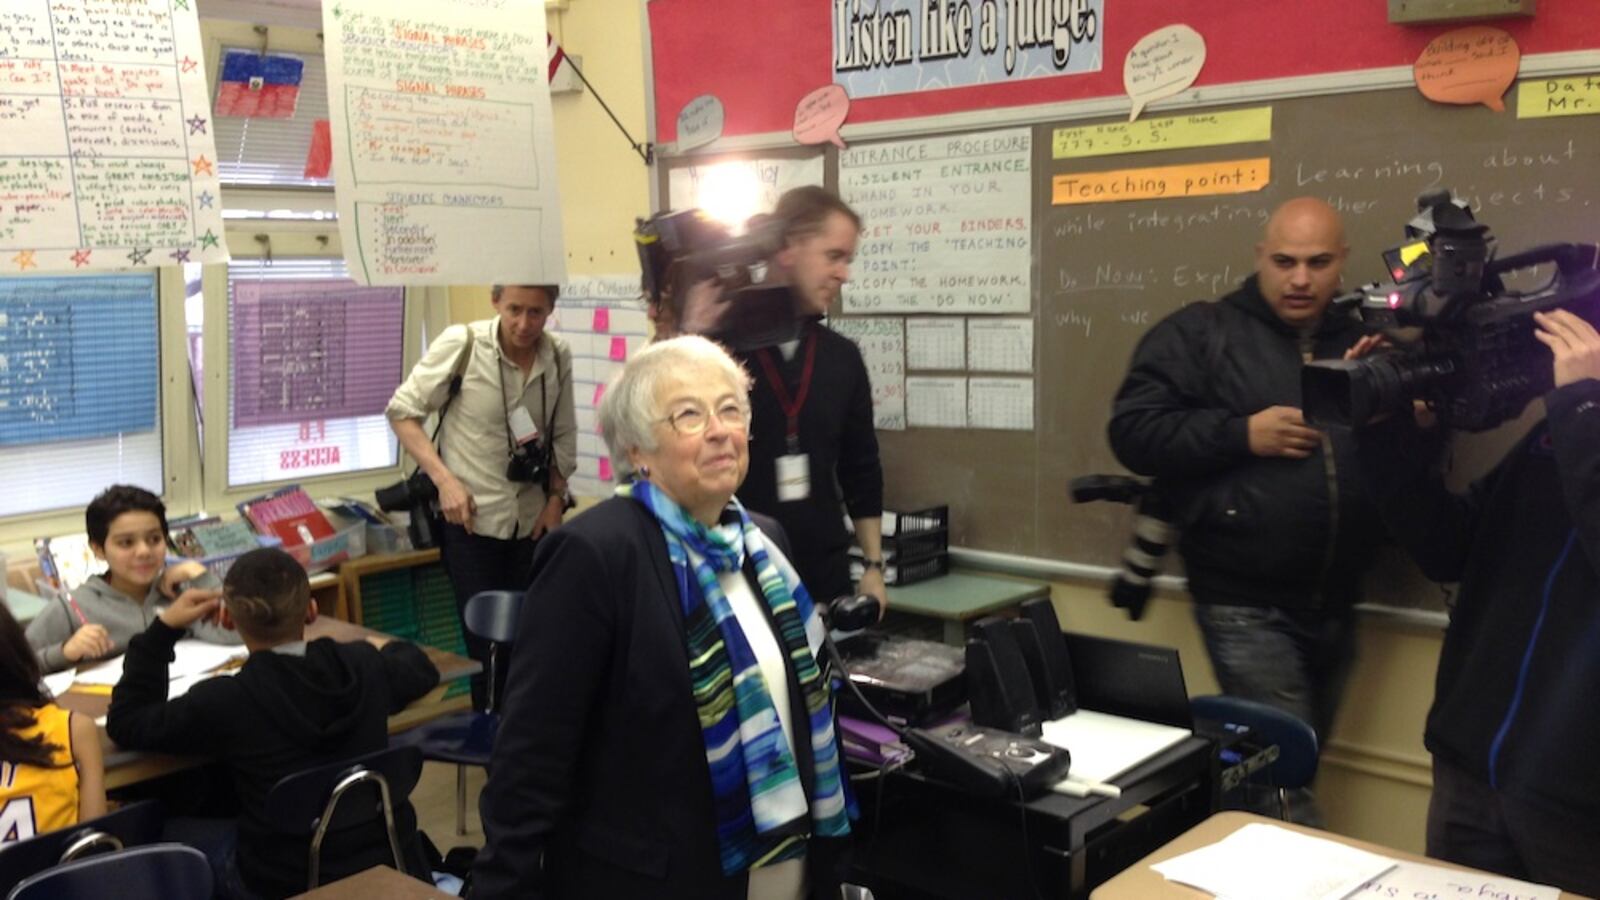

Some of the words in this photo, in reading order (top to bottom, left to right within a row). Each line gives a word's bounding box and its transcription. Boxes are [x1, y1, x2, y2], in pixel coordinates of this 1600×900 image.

[68, 15, 81, 24] As
[395, 26, 439, 43] SIGNAL
[443, 34, 487, 50] PHRASES
[836, 0, 913, 73] Listen
[919, 0, 972, 62] like
[980, 0, 998, 54] a
[1004, 0, 1096, 76] judge.
[395, 79, 439, 93] SIGNAL
[444, 85, 487, 98] PHRASES
[1547, 97, 1592, 113] Mr.
[1188, 115, 1218, 125] Name
[840, 143, 928, 167] ENTRANCE
[946, 135, 1031, 156] PROCEDURE
[940, 158, 1030, 179] ENTRANCE.
[1296, 160, 1443, 187] Learning
[1483, 139, 1576, 169] about
[911, 186, 932, 197] IN
[949, 180, 1002, 196] YOUR
[1059, 178, 1167, 199] Teaching
[1185, 168, 1257, 195] point:
[1053, 213, 1106, 237] while
[1127, 205, 1270, 233] integrating
[1326, 196, 1378, 215] ther
[859, 225, 893, 239] GET
[905, 222, 942, 236] YOUR
[960, 217, 1028, 232] BINDERS.
[909, 241, 931, 253] THE
[939, 274, 1027, 288] HOMEWORK.
[1059, 269, 1077, 287] Do
[1095, 263, 1159, 288] Now:
[896, 294, 919, 306] THE
[1056, 310, 1093, 337] why
